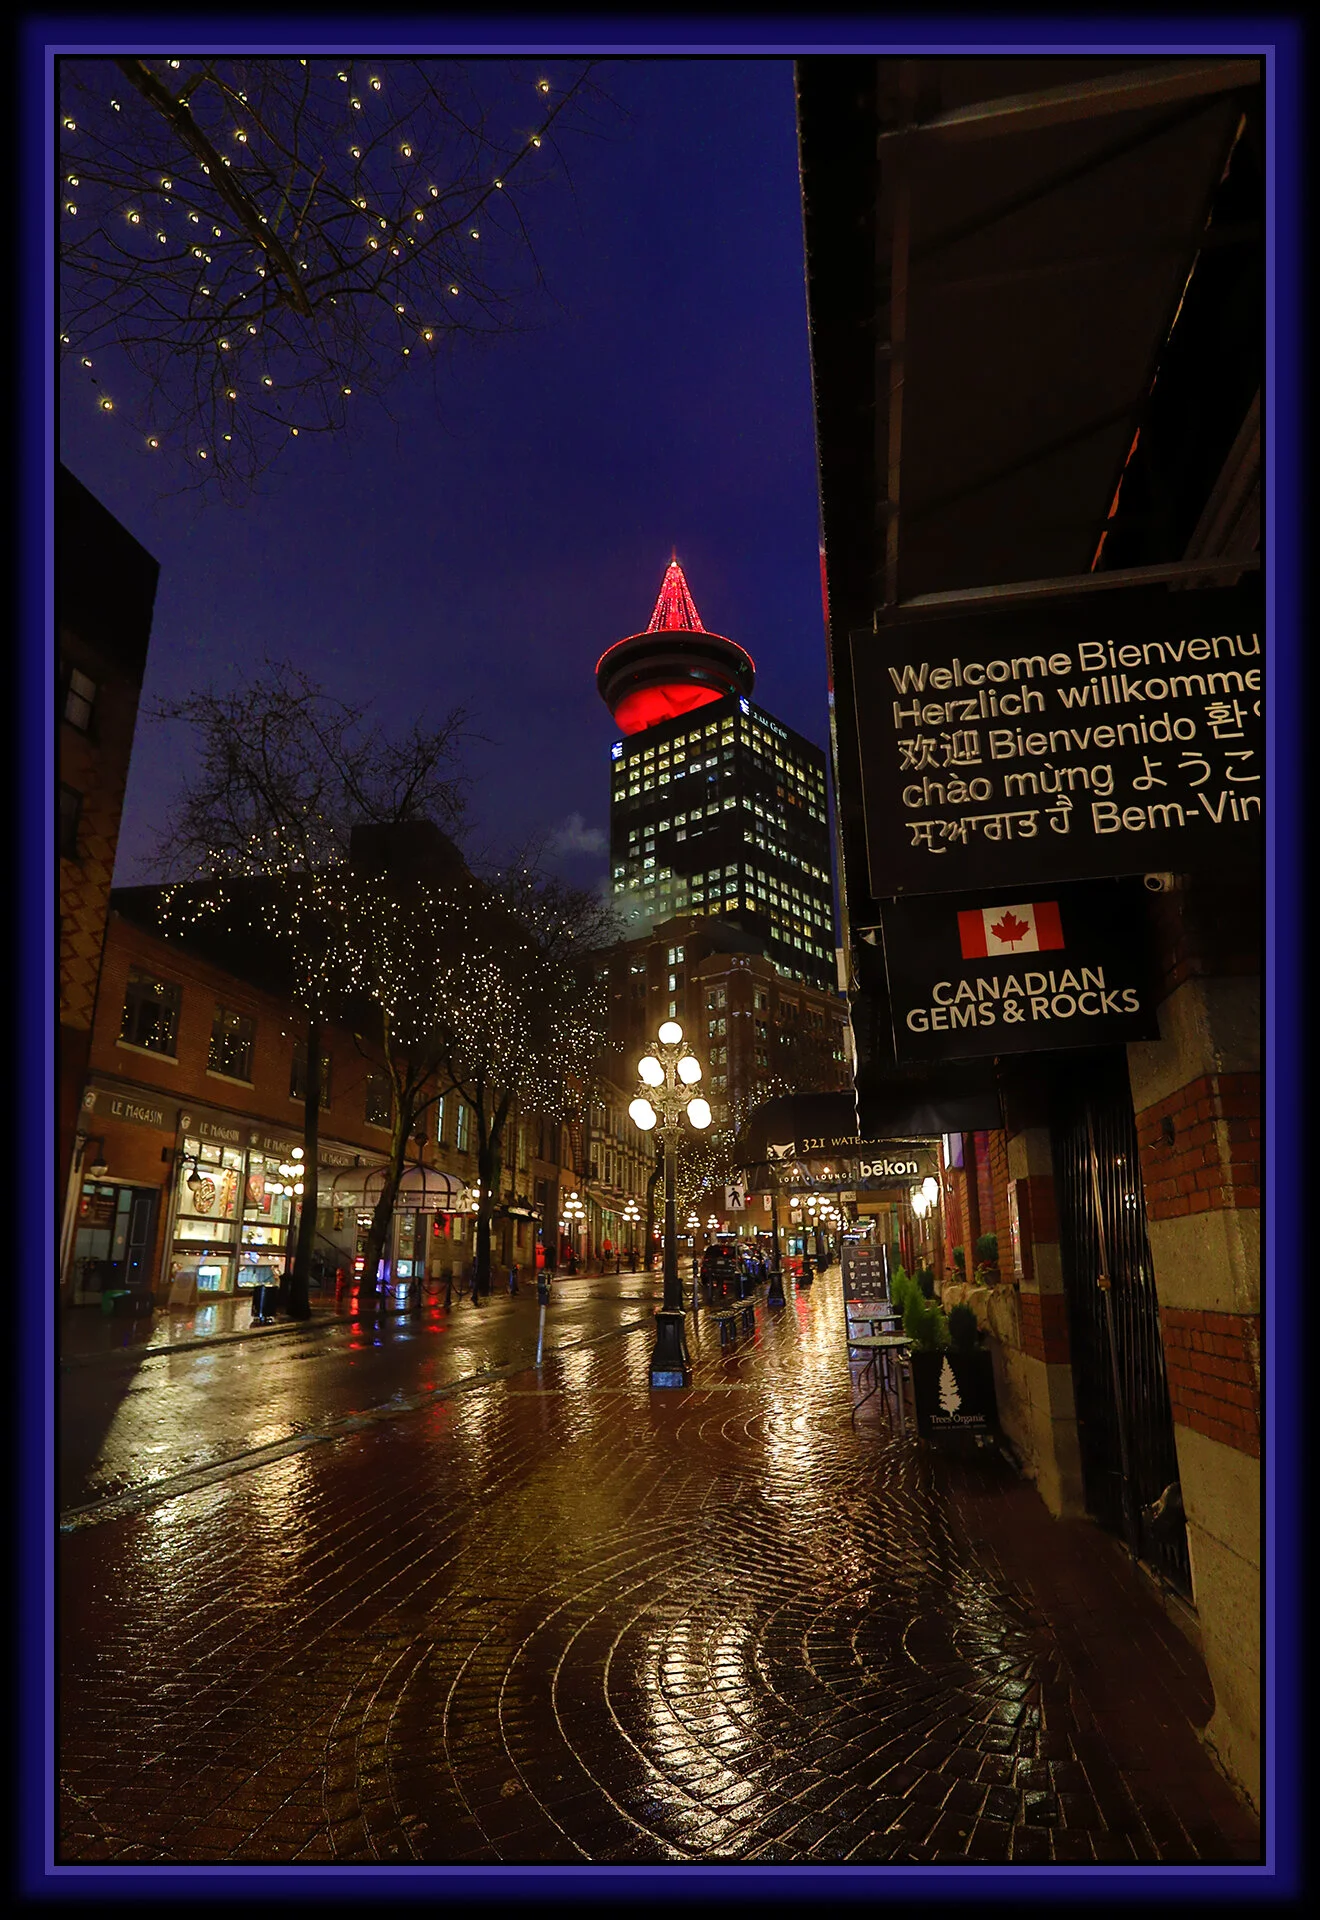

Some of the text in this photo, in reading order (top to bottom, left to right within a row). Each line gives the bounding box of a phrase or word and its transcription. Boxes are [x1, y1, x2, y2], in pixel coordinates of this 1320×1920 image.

[888, 633, 1261, 695] Welcome Bienvenu
[893, 667, 1261, 730] Herzlich willkomme
[897, 728, 983, 772] 欢迎
[988, 712, 1196, 760] Bienvenido
[902, 772, 993, 809] chào
[1045, 794, 1073, 835] ਹੈ
[931, 966, 1107, 1006] CANADIAN
[906, 988, 1141, 1033] GEMS & ROCKS
[111, 1099, 164, 1125] LE MAGASIN
[802, 1137, 826, 1153] 321
[859, 1159, 917, 1177] bēkon
[929, 1412, 986, 1425] Trees Organic
